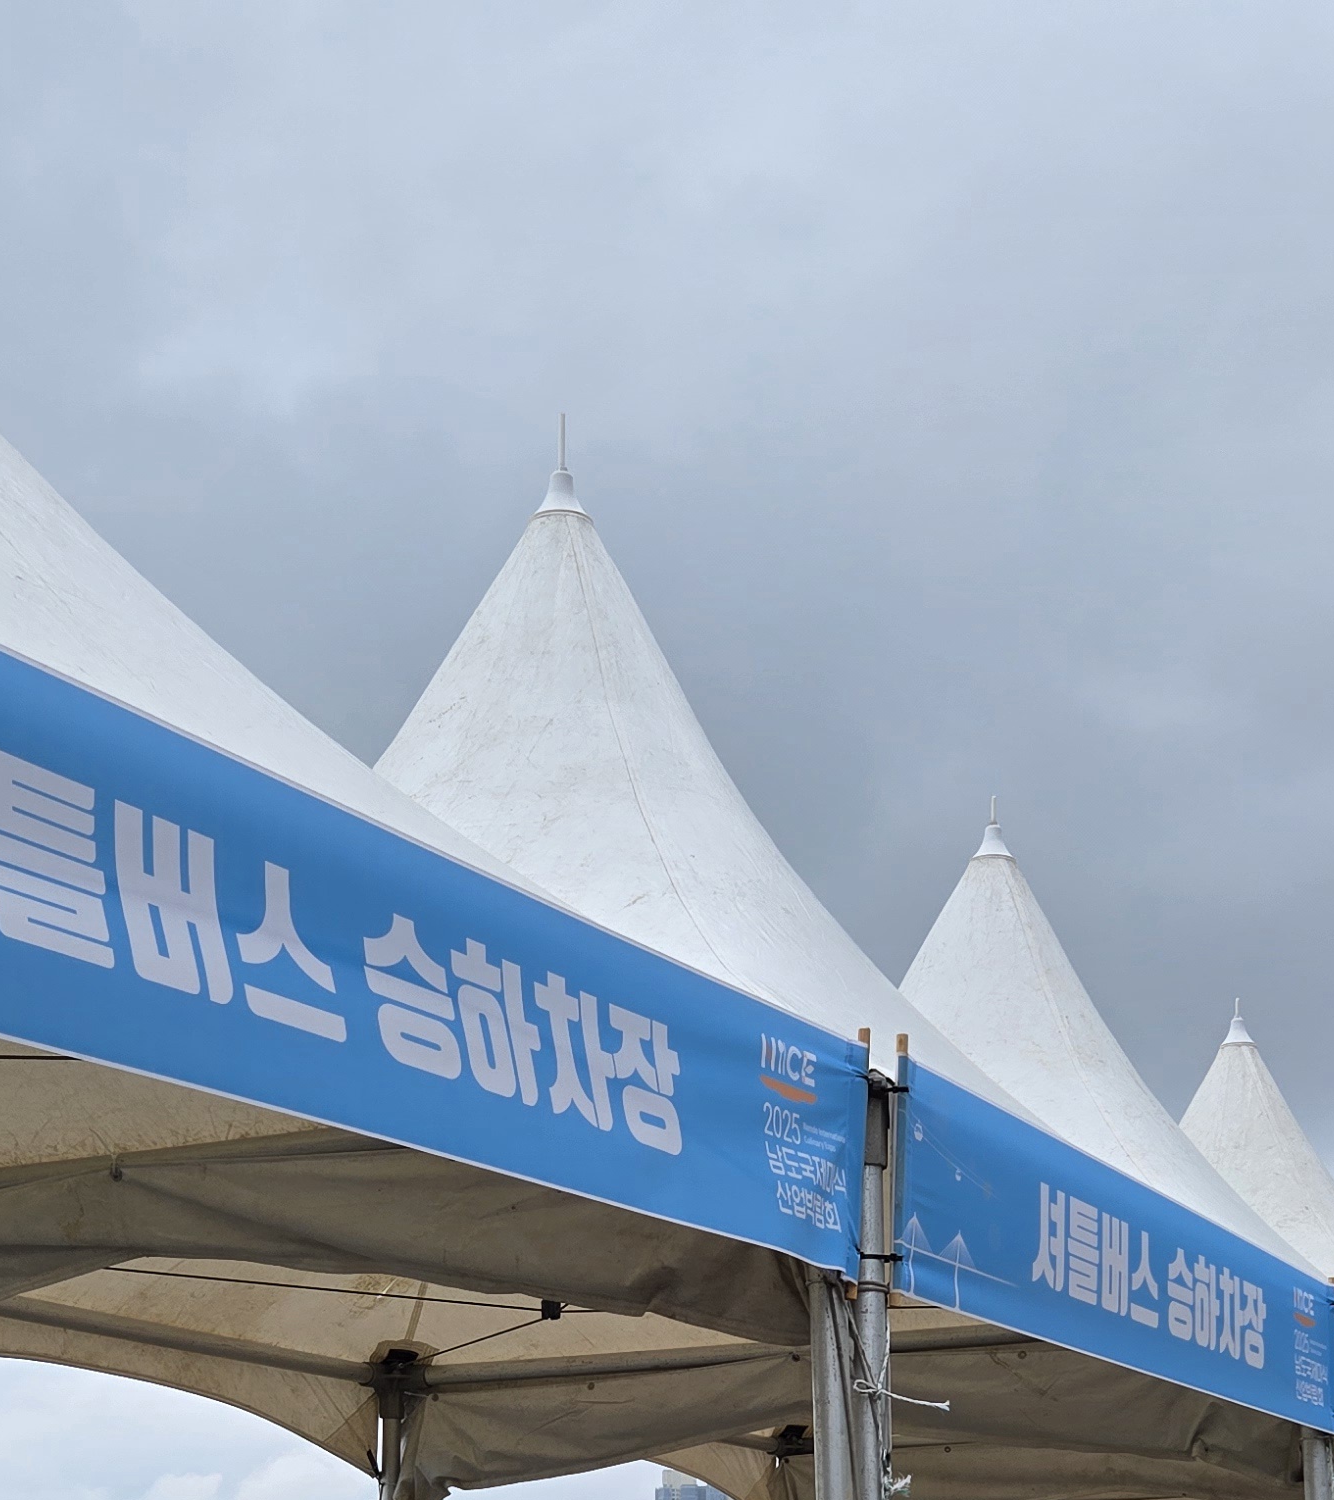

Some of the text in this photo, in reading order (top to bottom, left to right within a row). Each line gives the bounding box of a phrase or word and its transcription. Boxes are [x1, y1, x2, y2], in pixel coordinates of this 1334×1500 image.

[364, 913, 682, 1156] 승하차장
[763, 1101, 802, 1145] 2025
[764, 1140, 847, 1198] 남도국제미식
[776, 1180, 842, 1233] 산업박람회
[1032, 1181, 1267, 1370] 셔틀버스 승하차장
